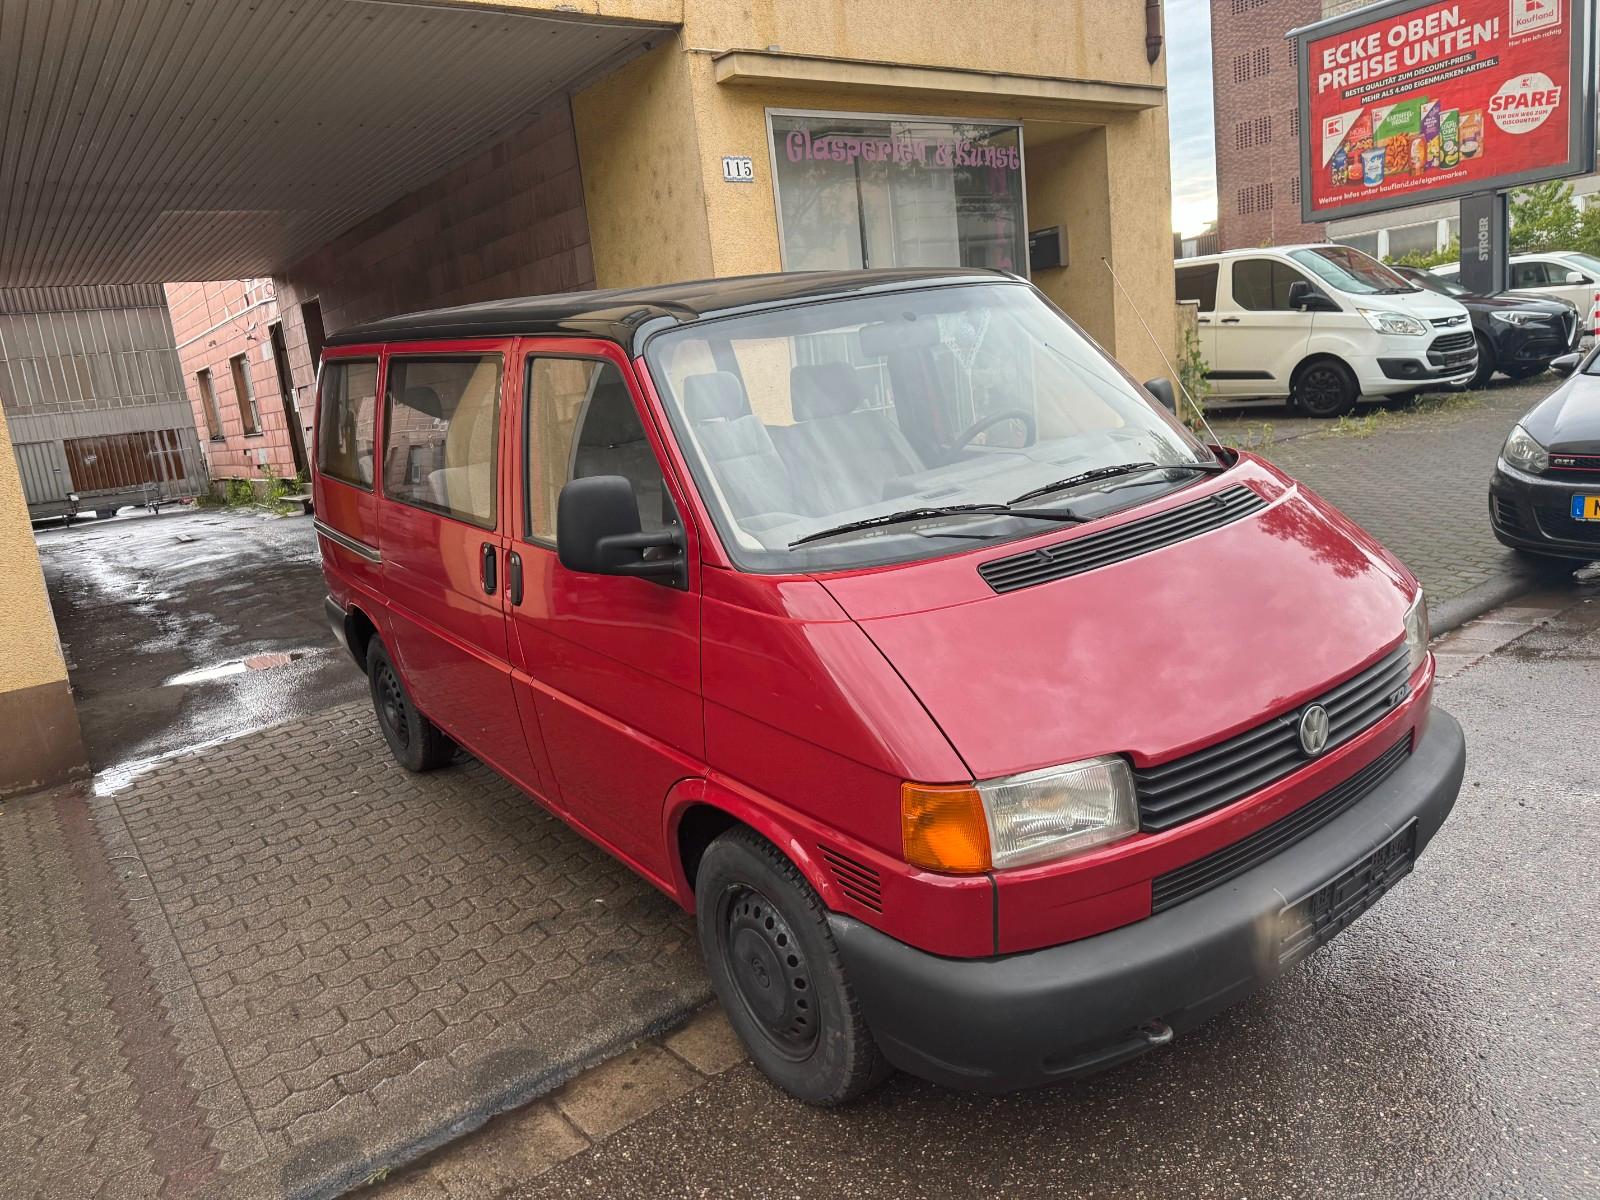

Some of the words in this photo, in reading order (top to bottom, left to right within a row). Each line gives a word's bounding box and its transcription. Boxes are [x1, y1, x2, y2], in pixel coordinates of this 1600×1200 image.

[1323, 32, 1381, 70] ECKE
[1387, 5, 1466, 47] OBEN.
[1508, 39, 1521, 47] Hier
[1532, 33, 1542, 41] ich
[1542, 28, 1562, 37] richtig
[1516, 9, 1554, 26] Kaufland
[1318, 50, 1398, 94] PREISE
[1403, 16, 1499, 66] UNTEN!
[1345, 85, 1365, 97] BESTE
[1365, 75, 1397, 91] QUALITÄT
[1398, 70, 1413, 82] ZUM
[1414, 53, 1473, 77] DISCOUNT-PREIS:
[1361, 92, 1380, 104] MEHR
[1381, 88, 1394, 98] ALS
[1394, 83, 1413, 94] 4.400
[1414, 58, 1499, 88] EIGENMARKEN-ARTIKEL.
[1490, 89, 1559, 112] SPARE
[726, 161, 752, 177] 115
[786, 127, 926, 165] Glasperlen
[952, 138, 1020, 170] Kunst
[1318, 194, 1343, 205] Weitere
[1344, 191, 1360, 199] Infos
[1360, 187, 1378, 195] unter
[1380, 170, 1467, 192] kaufland.de/eigenmarken
[1478, 216, 1489, 262] STRÖER
